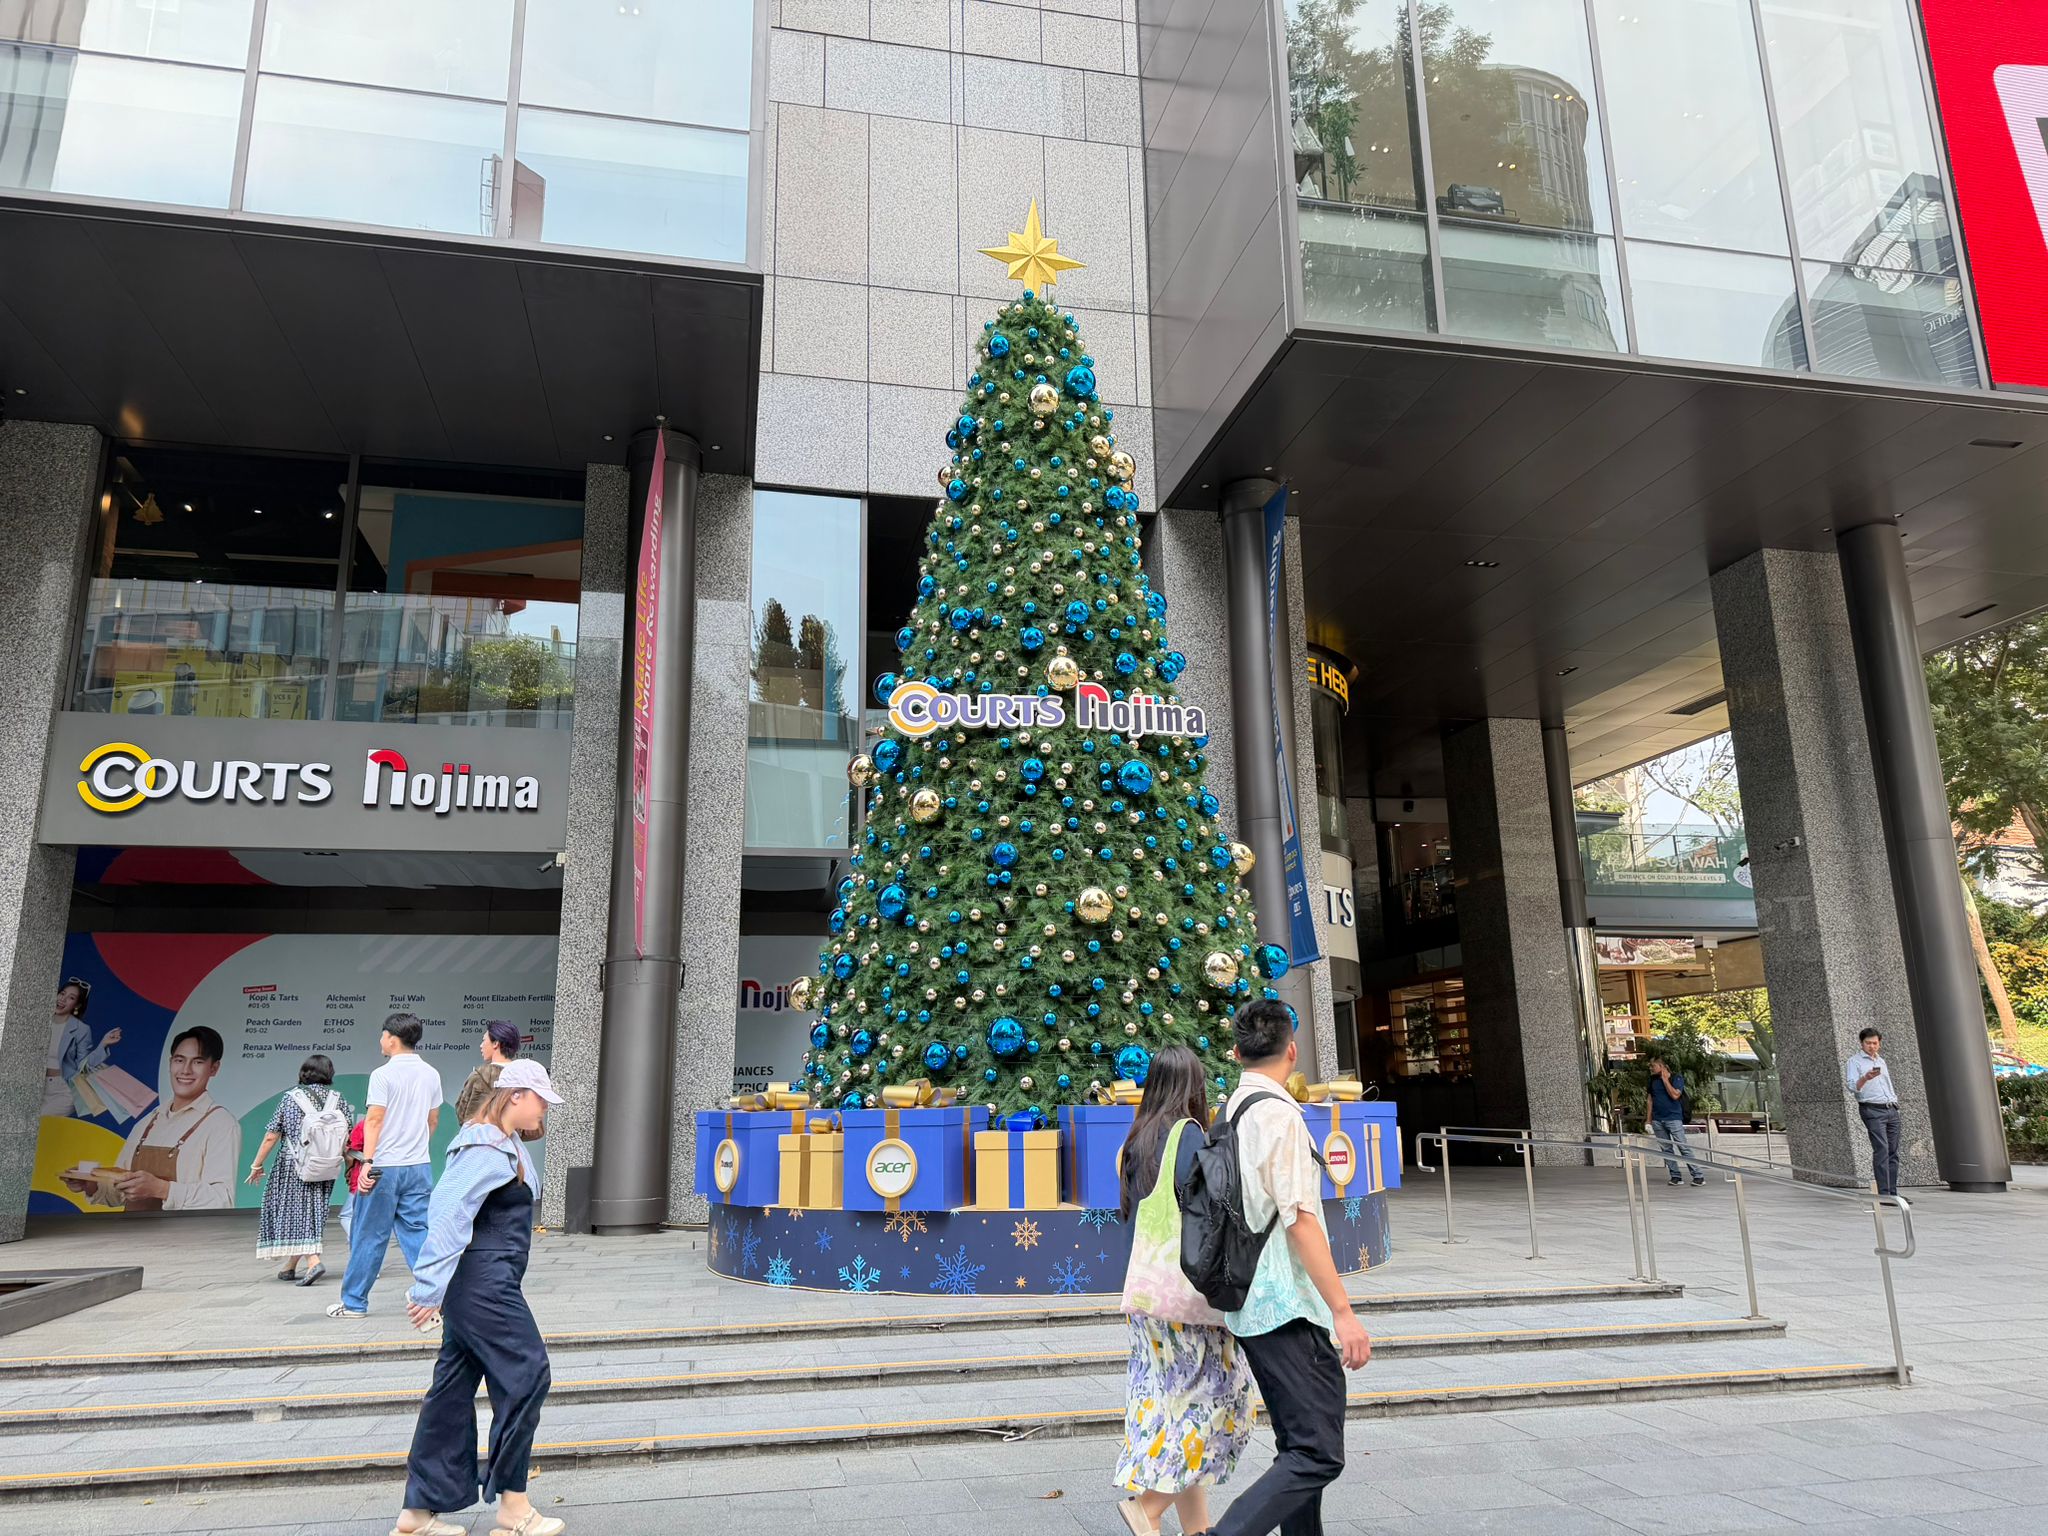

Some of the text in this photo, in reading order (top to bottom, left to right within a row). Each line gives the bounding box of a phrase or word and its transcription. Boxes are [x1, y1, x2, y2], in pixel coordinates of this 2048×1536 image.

[637, 571, 648, 624] Life
[635, 630, 647, 709] Make
[889, 682, 1064, 735] COURTS
[78, 743, 332, 812] COURTS
[1688, 856, 1728, 869] WAH
[249, 993, 269, 1002] Kopi
[278, 993, 299, 1001] Tarts
[326, 994, 366, 1002] Alchemist
[390, 994, 425, 1002] Tsui Wah
[463, 994, 490, 1002] Mount
[491, 994, 526, 1002] Elizabeth
[246, 1018, 302, 1026] Peach Garden
[323, 1018, 355, 1026] E:THOS
[421, 1018, 446, 1026] Pilates
[462, 1018, 478, 1026] Slim
[530, 1018, 550, 1026] Hove
[243, 1043, 351, 1052] Renaza Wellness Facial Spa
[425, 1043, 441, 1051] Hair
[443, 1043, 470, 1052] People
[874, 1162, 912, 1173] acer
